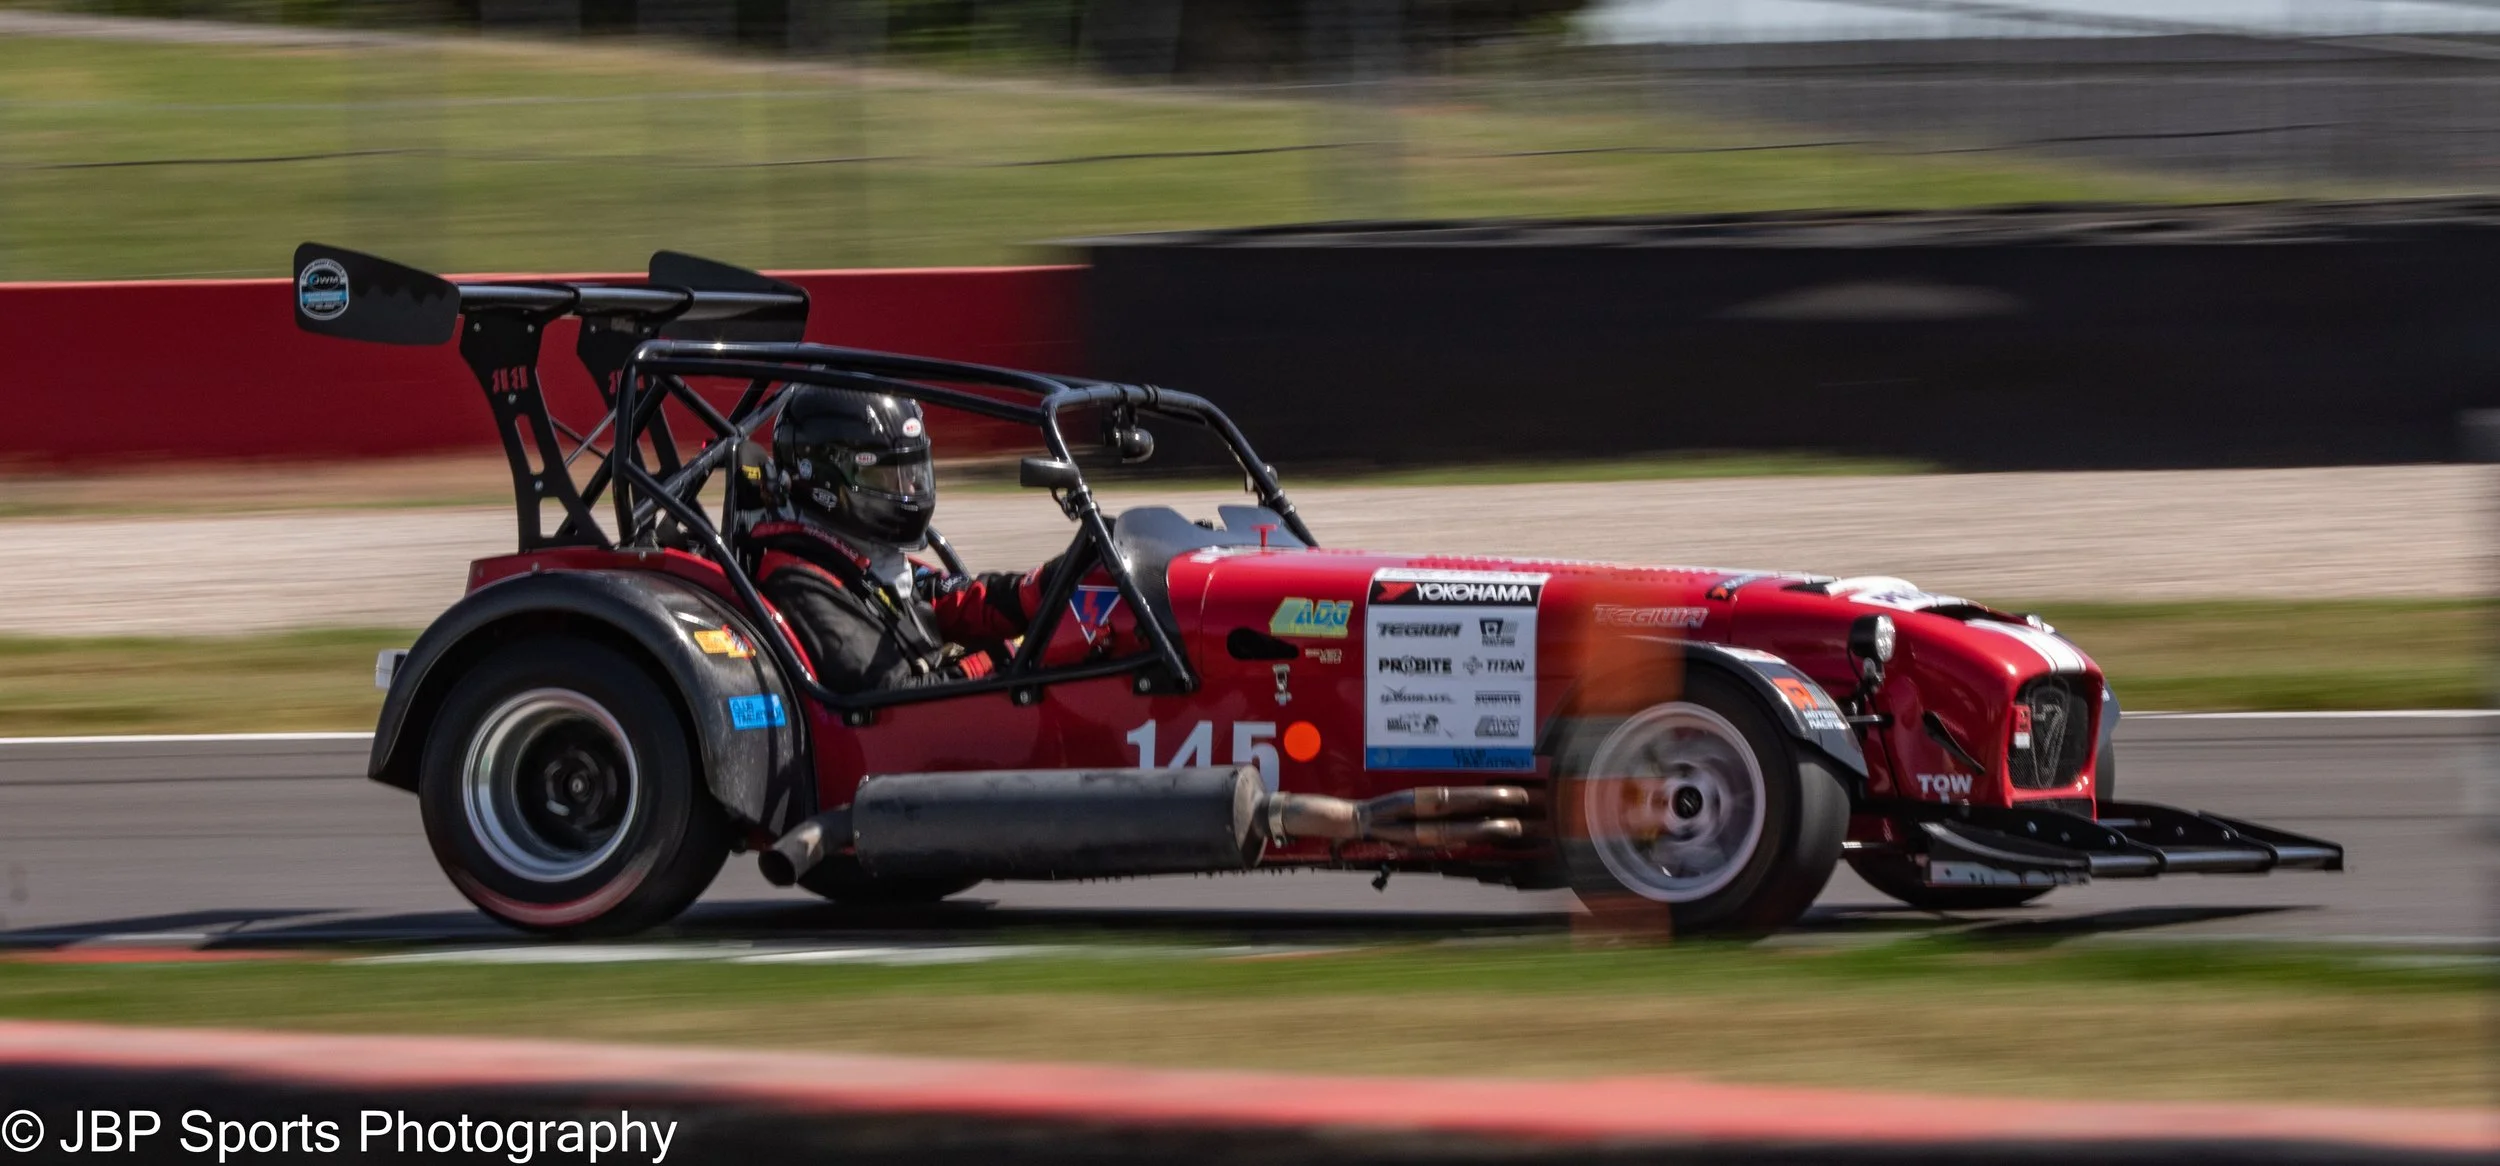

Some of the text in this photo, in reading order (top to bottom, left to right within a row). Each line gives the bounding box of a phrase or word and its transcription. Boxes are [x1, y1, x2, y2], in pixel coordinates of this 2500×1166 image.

[1416, 583, 1532, 602] YOKOHAMA
[1486, 658, 1525, 673] TITAN
[1127, 719, 1280, 793] 145
[1917, 774, 1973, 793] TOW
